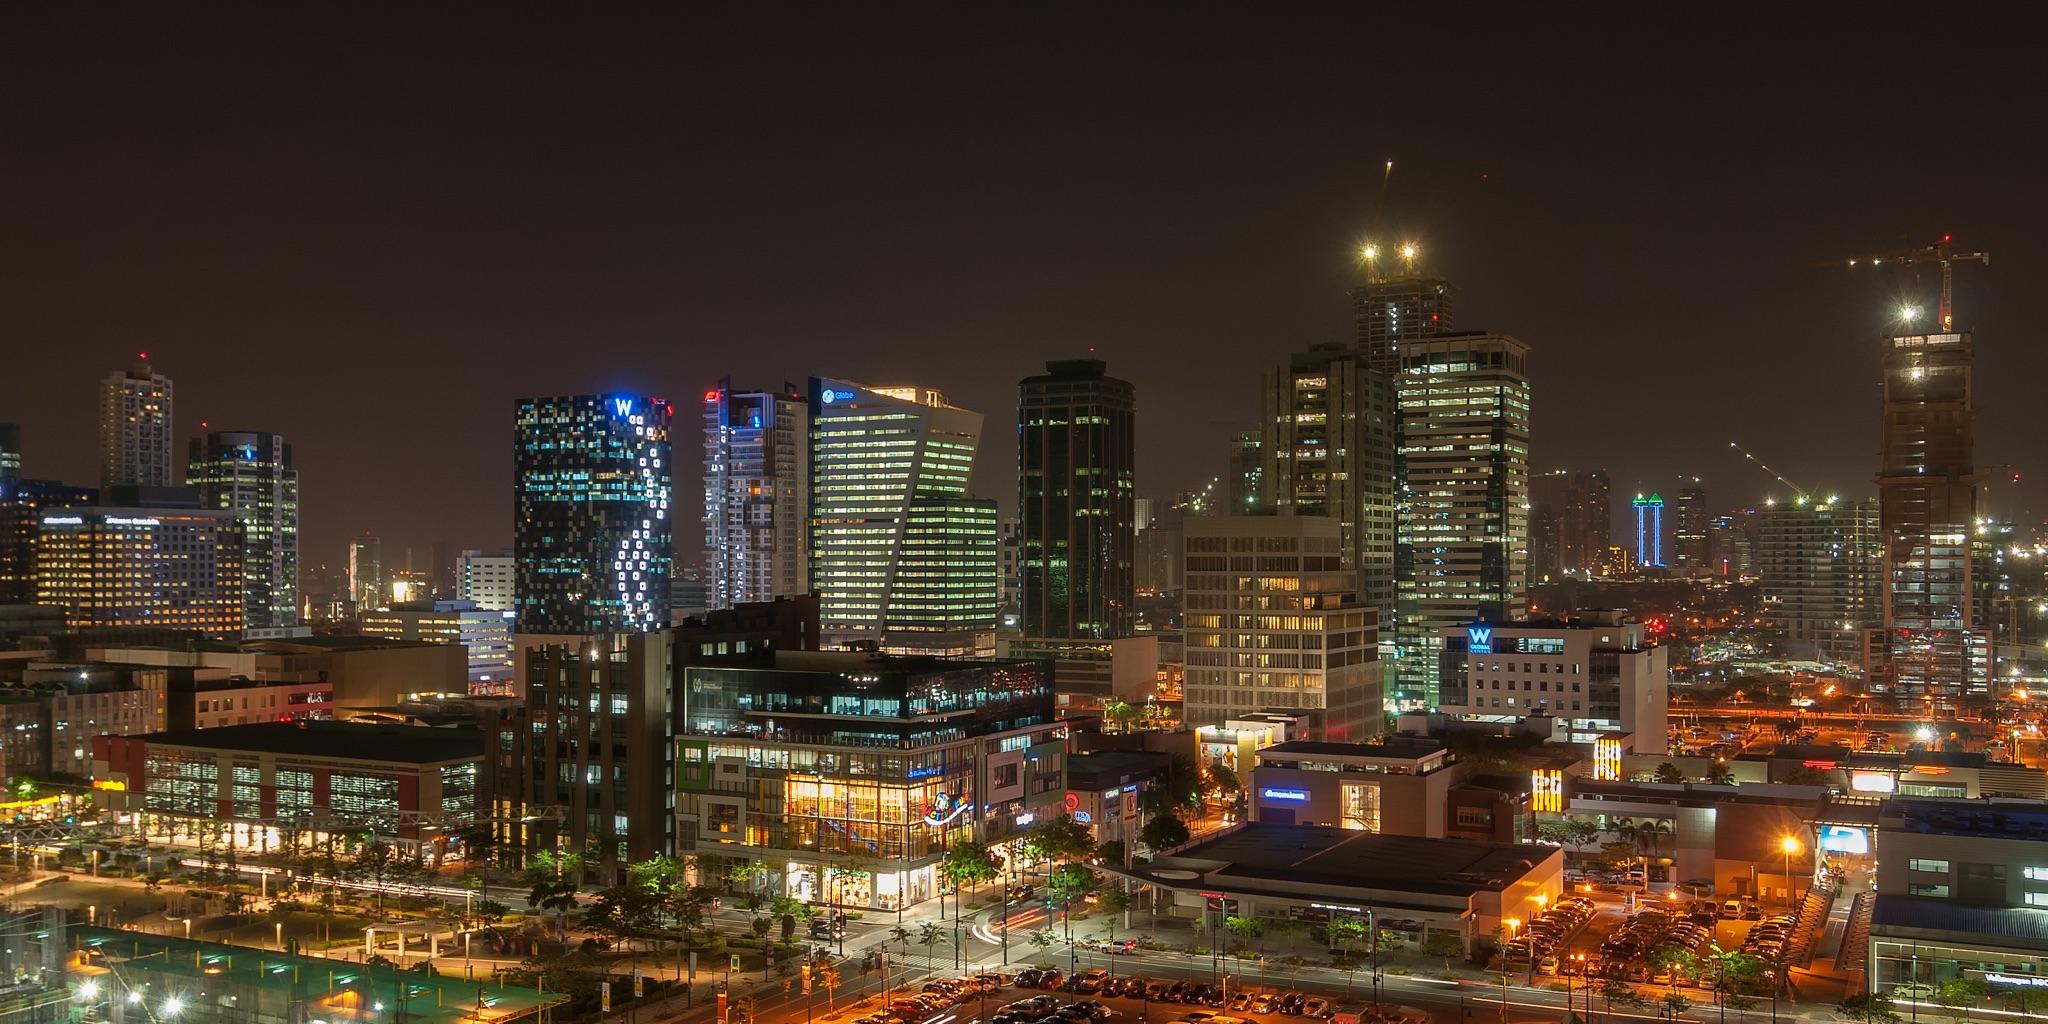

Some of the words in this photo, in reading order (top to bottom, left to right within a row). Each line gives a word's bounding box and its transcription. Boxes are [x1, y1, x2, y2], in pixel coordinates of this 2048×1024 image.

[835, 391, 854, 400] Globe
[615, 398, 632, 417] W
[1468, 628, 1491, 644] W
